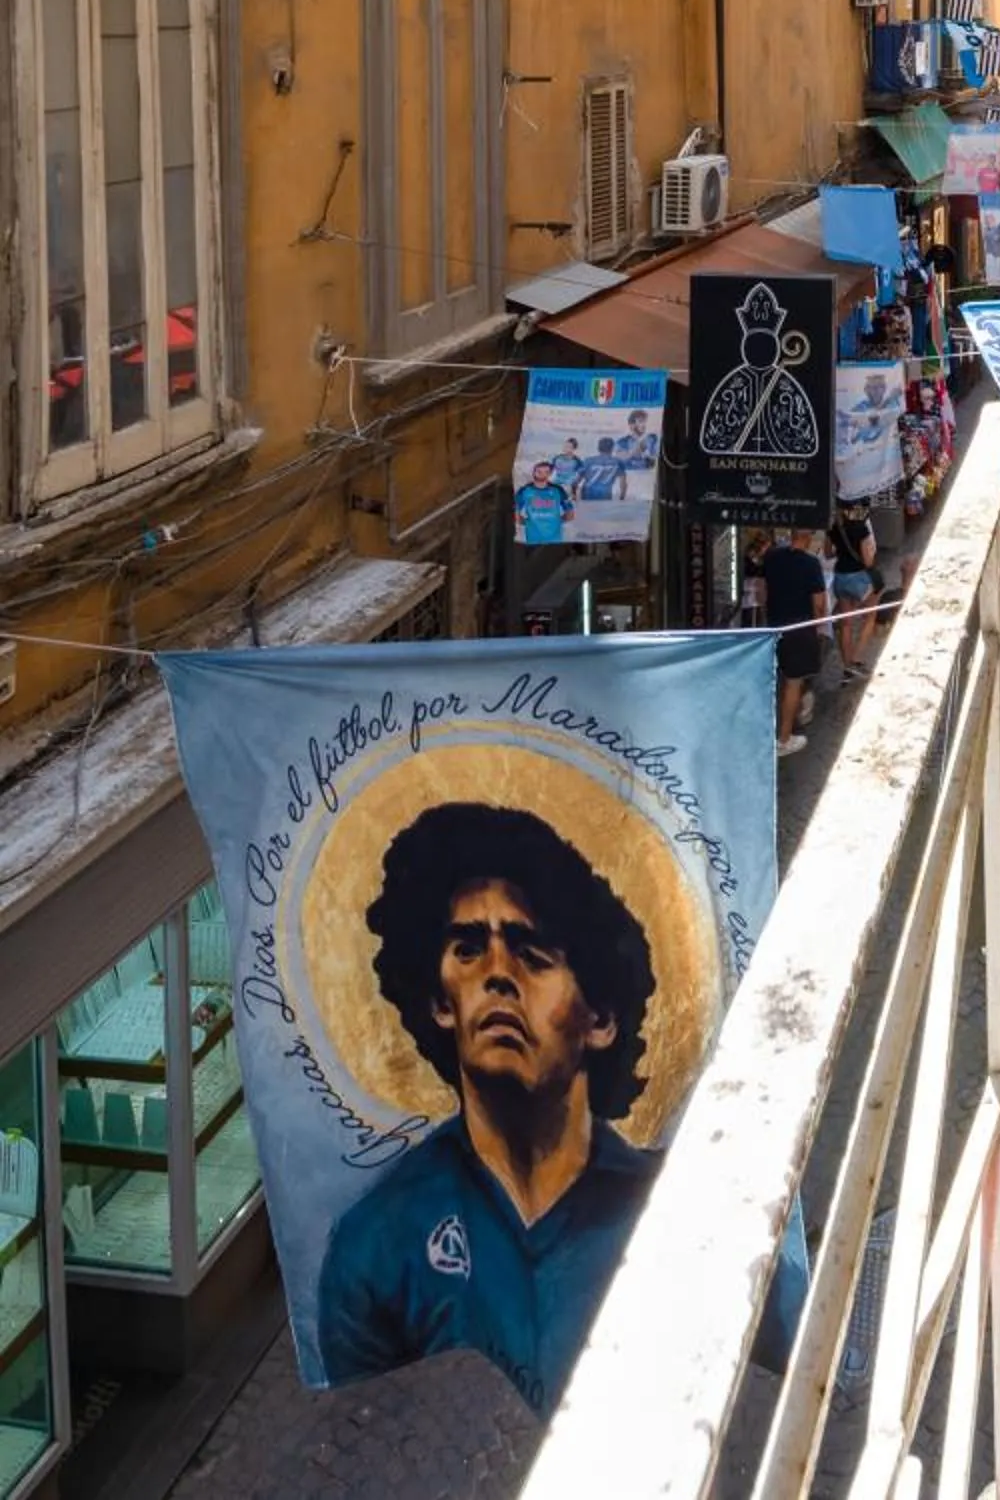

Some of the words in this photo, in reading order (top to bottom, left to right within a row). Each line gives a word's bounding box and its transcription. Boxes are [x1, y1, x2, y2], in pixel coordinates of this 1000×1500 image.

[245, 832, 292, 907] Por
[287, 765, 313, 823] el
[409, 692, 469, 753] por
[674, 831, 739, 897] por
